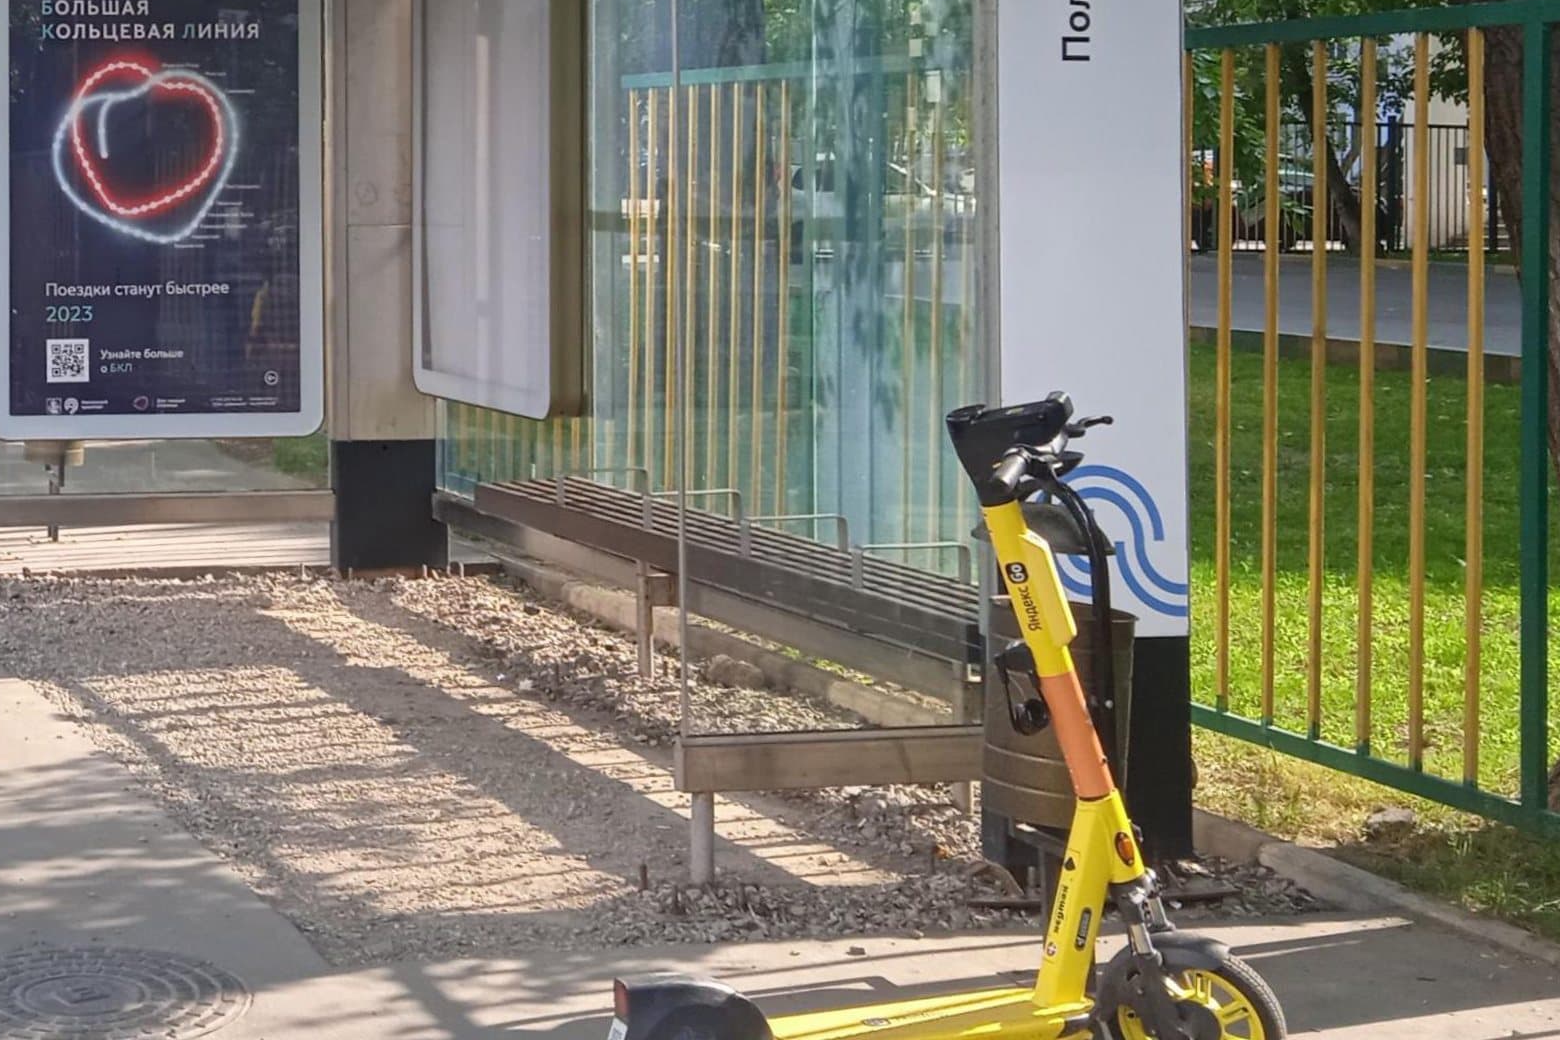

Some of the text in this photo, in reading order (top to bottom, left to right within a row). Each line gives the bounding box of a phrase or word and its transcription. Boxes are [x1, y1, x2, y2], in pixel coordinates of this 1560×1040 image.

[41, 0, 149, 16] БОЛЬШАЯ
[41, 23, 260, 42] КОЛЬЦЕВАЯ ЛИНИЯ
[45, 281, 230, 298] Поездки станут быстрее
[45, 305, 93, 323] 2023
[100, 347, 184, 360] Узнайте больше
[109, 362, 133, 373] БКЛ
[1010, 563, 1043, 631] Яндекс Go
